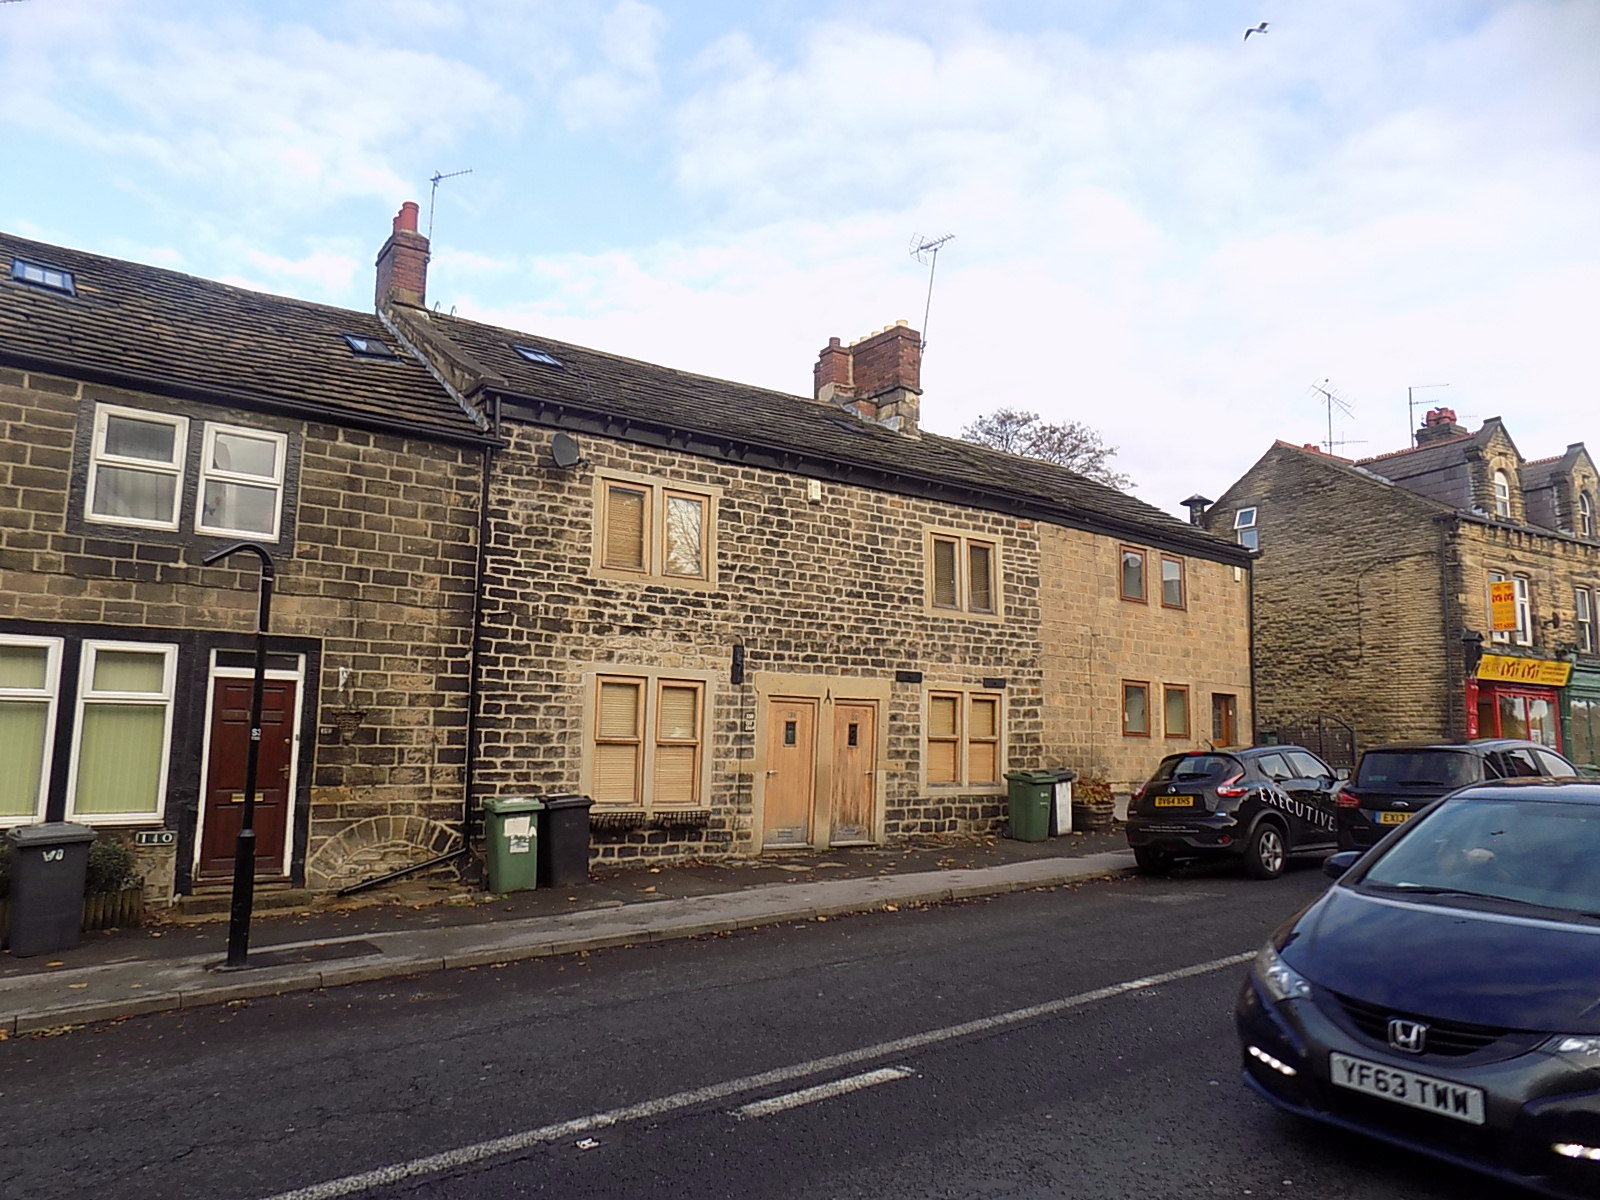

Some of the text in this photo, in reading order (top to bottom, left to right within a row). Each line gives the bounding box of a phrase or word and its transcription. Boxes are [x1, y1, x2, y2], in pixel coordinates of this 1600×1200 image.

[1259, 786, 1335, 832] EXECUTIVE
[141, 833, 173, 843] 140
[1342, 1059, 1469, 1117] YF63 TWW
